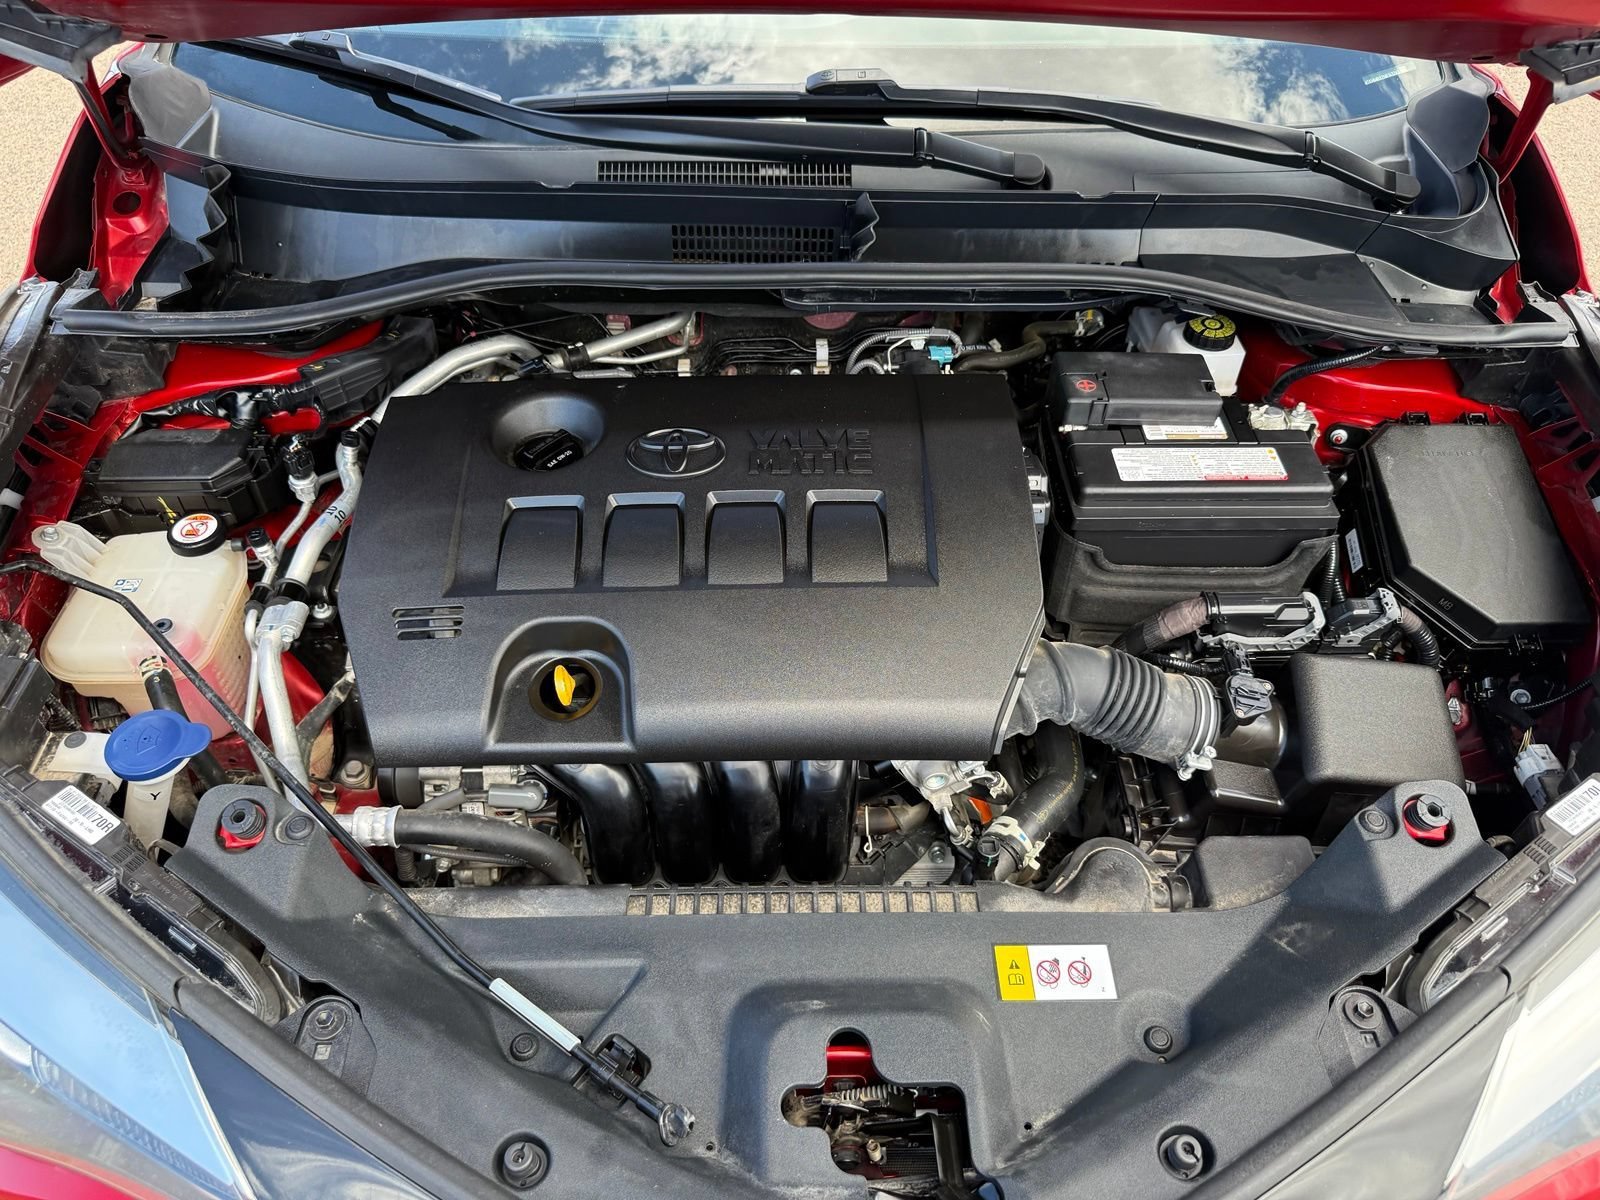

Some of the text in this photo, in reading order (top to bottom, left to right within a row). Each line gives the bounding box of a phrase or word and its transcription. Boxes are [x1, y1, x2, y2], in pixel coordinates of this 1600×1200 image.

[747, 428, 871, 450] VALVE
[547, 459, 558, 468] SAE
[748, 452, 873, 474] MATIC
[334, 509, 347, 524] 10
[91, 813, 114, 833] 70R
